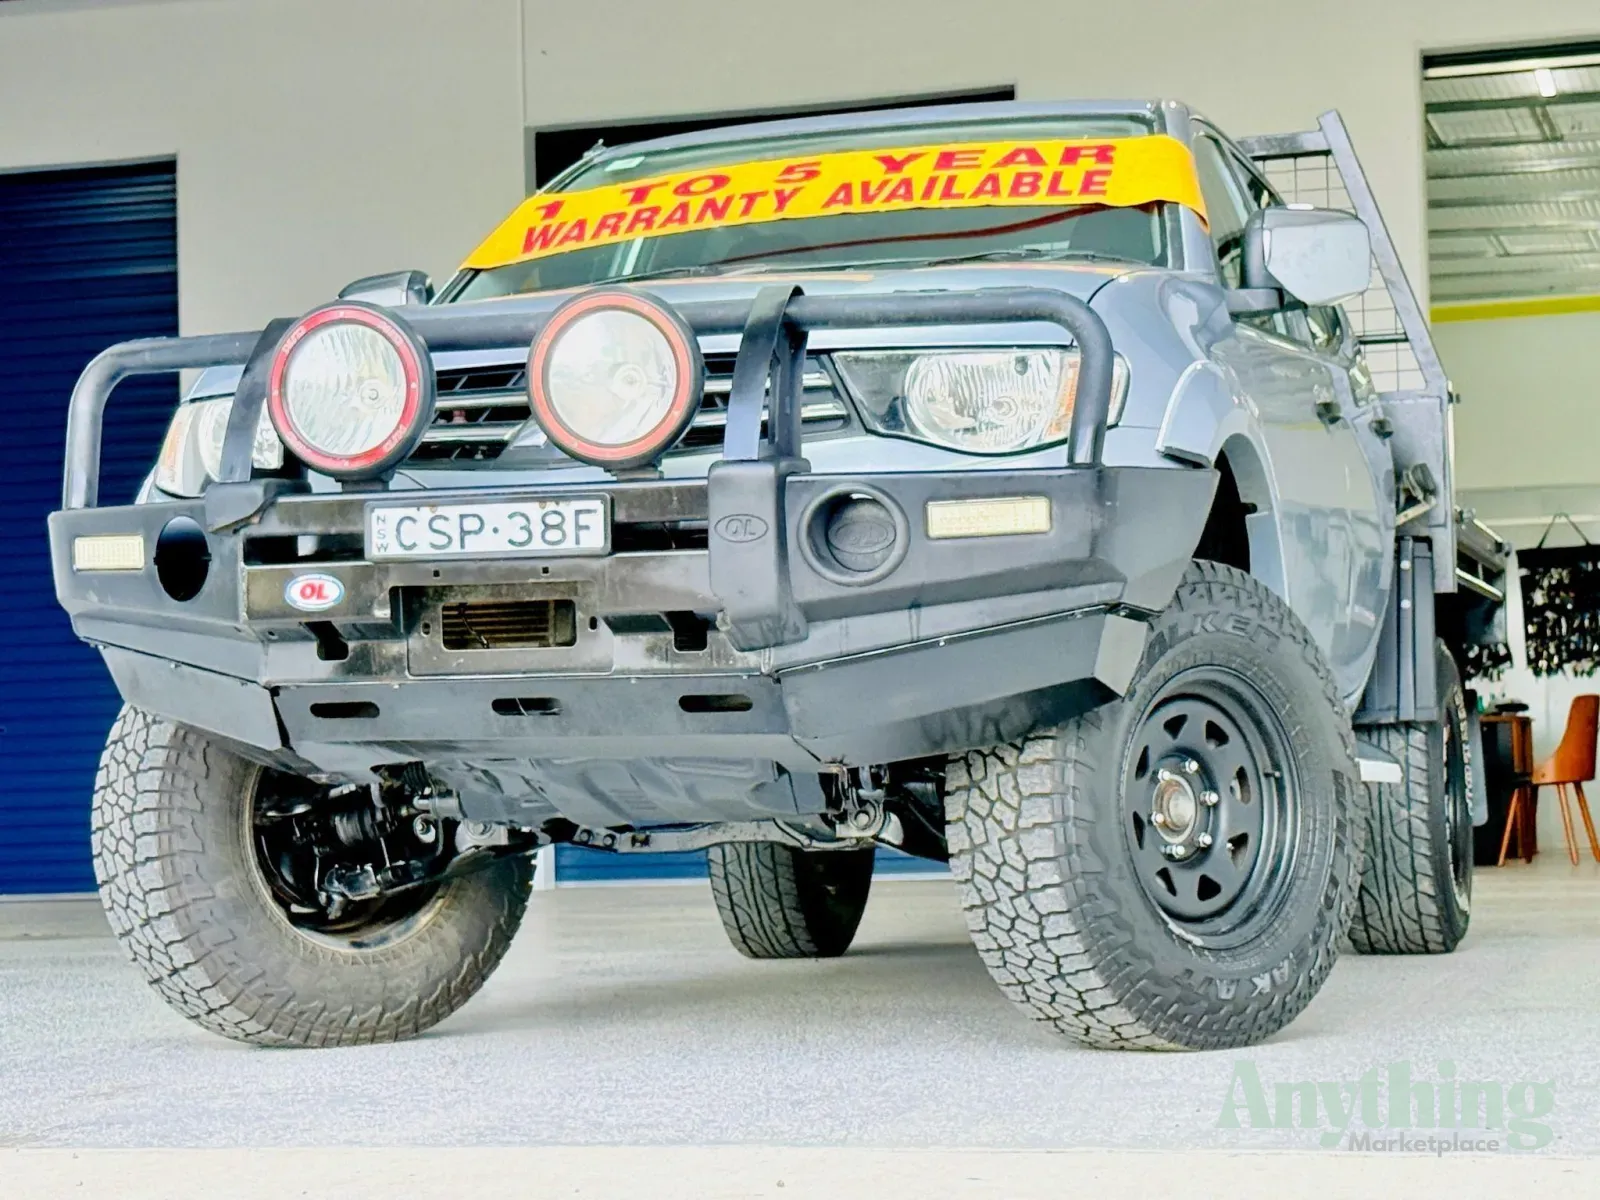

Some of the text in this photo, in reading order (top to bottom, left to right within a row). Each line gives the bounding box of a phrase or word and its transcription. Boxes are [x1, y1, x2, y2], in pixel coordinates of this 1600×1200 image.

[520, 169, 1114, 254] WARRANTY AVAILABLE
[534, 144, 1118, 221] 1 TO 5 YEAR
[299, 582, 330, 601] OL
